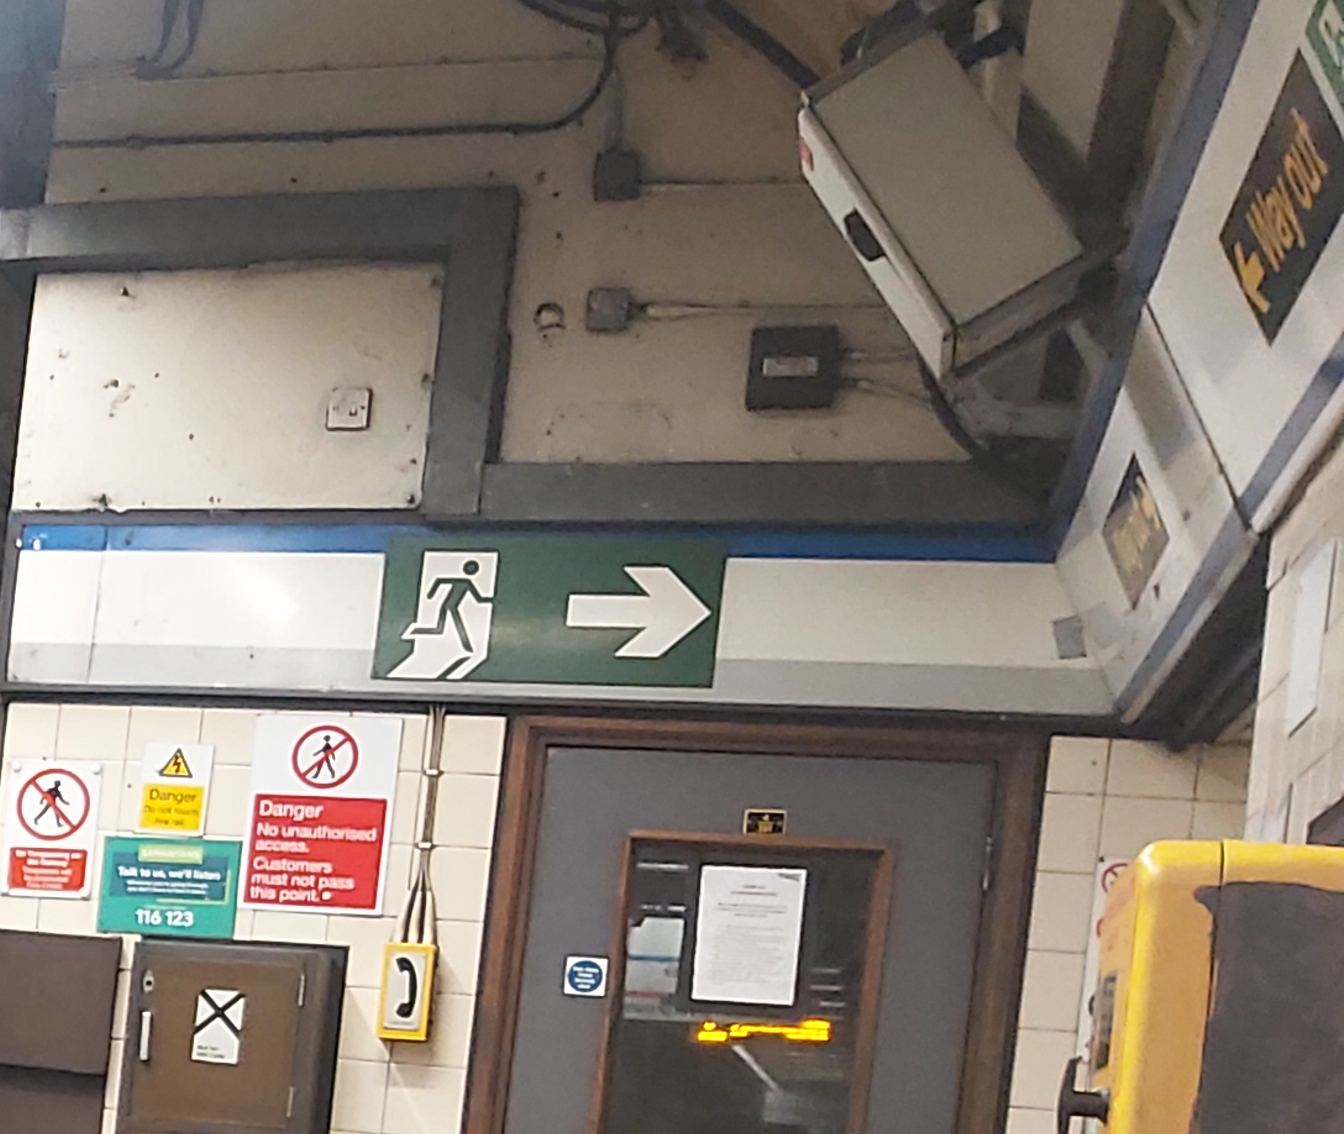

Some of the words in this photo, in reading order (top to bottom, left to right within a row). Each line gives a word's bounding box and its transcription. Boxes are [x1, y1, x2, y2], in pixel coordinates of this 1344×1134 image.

[1245, 175, 1307, 273] Way
[1284, 107, 1330, 210] out
[149, 788, 197, 804] Danger
[259, 800, 324, 821] Danger
[256, 823, 279, 837] No
[281, 825, 378, 841] unauthorised
[255, 839, 310, 853] access.
[117, 866, 138, 878] Talk
[139, 867, 151, 878] to
[193, 869, 222, 881] listen
[252, 856, 333, 874] Customers
[251, 873, 288, 886] must
[290, 875, 315, 887] not
[318, 876, 355, 890] pass
[250, 885, 277, 899] this
[278, 888, 320, 903] point.
[135, 909, 162, 925] 116
[165, 910, 194, 927] 123
